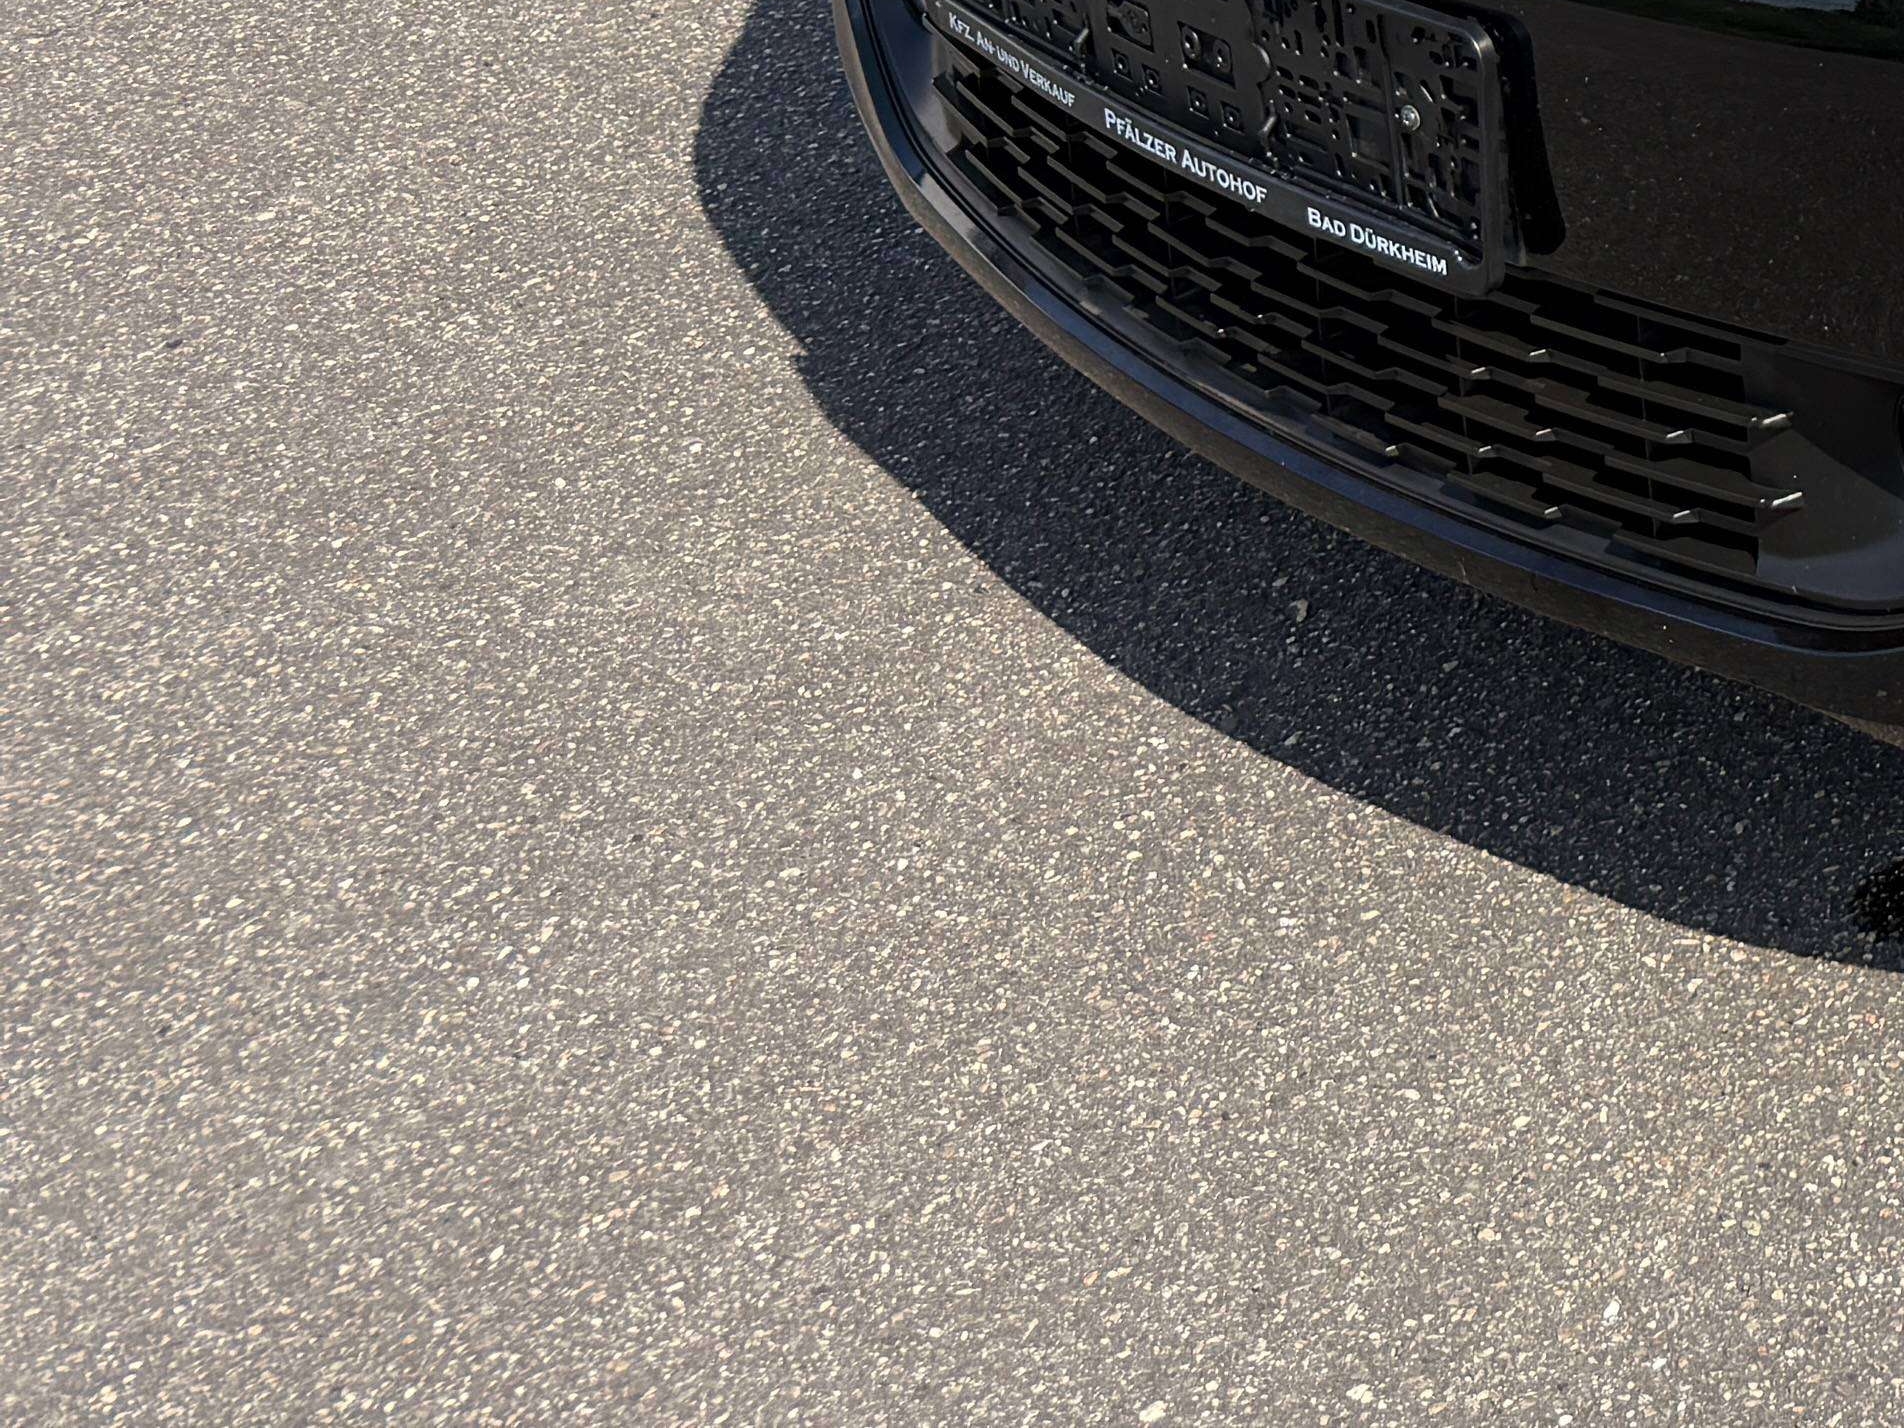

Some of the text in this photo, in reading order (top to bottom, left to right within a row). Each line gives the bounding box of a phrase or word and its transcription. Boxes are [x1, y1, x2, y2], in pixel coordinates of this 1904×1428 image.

[1020, 59, 1076, 108] VERKAUF
[1104, 108, 1268, 204] PFÄLZER AUTOHOF
[1307, 207, 1448, 276] BAD DÜRKHEIM
